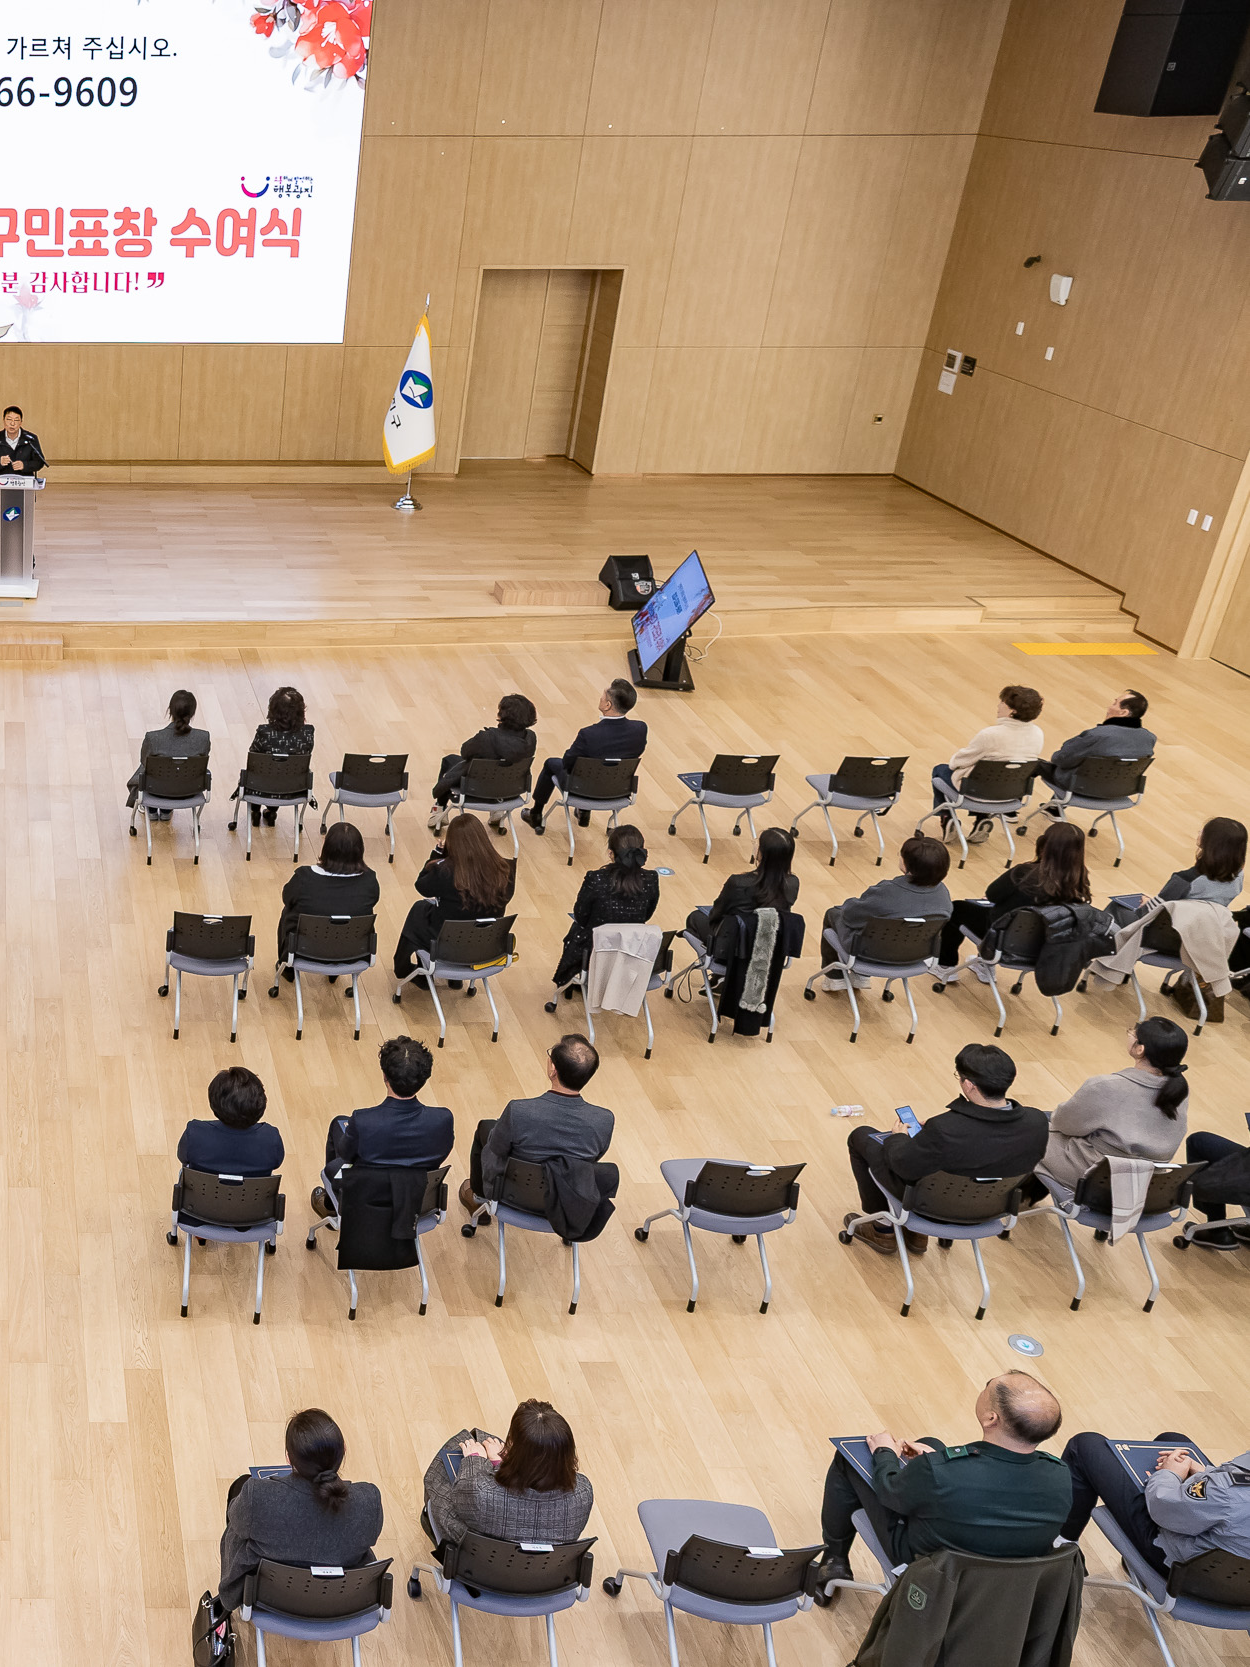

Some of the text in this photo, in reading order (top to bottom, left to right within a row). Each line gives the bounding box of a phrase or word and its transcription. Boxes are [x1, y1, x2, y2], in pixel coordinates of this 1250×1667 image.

[6, 36, 71, 60] 가르쳐
[82, 35, 177, 60] 주십시오.
[170, 207, 302, 258] 수여식
